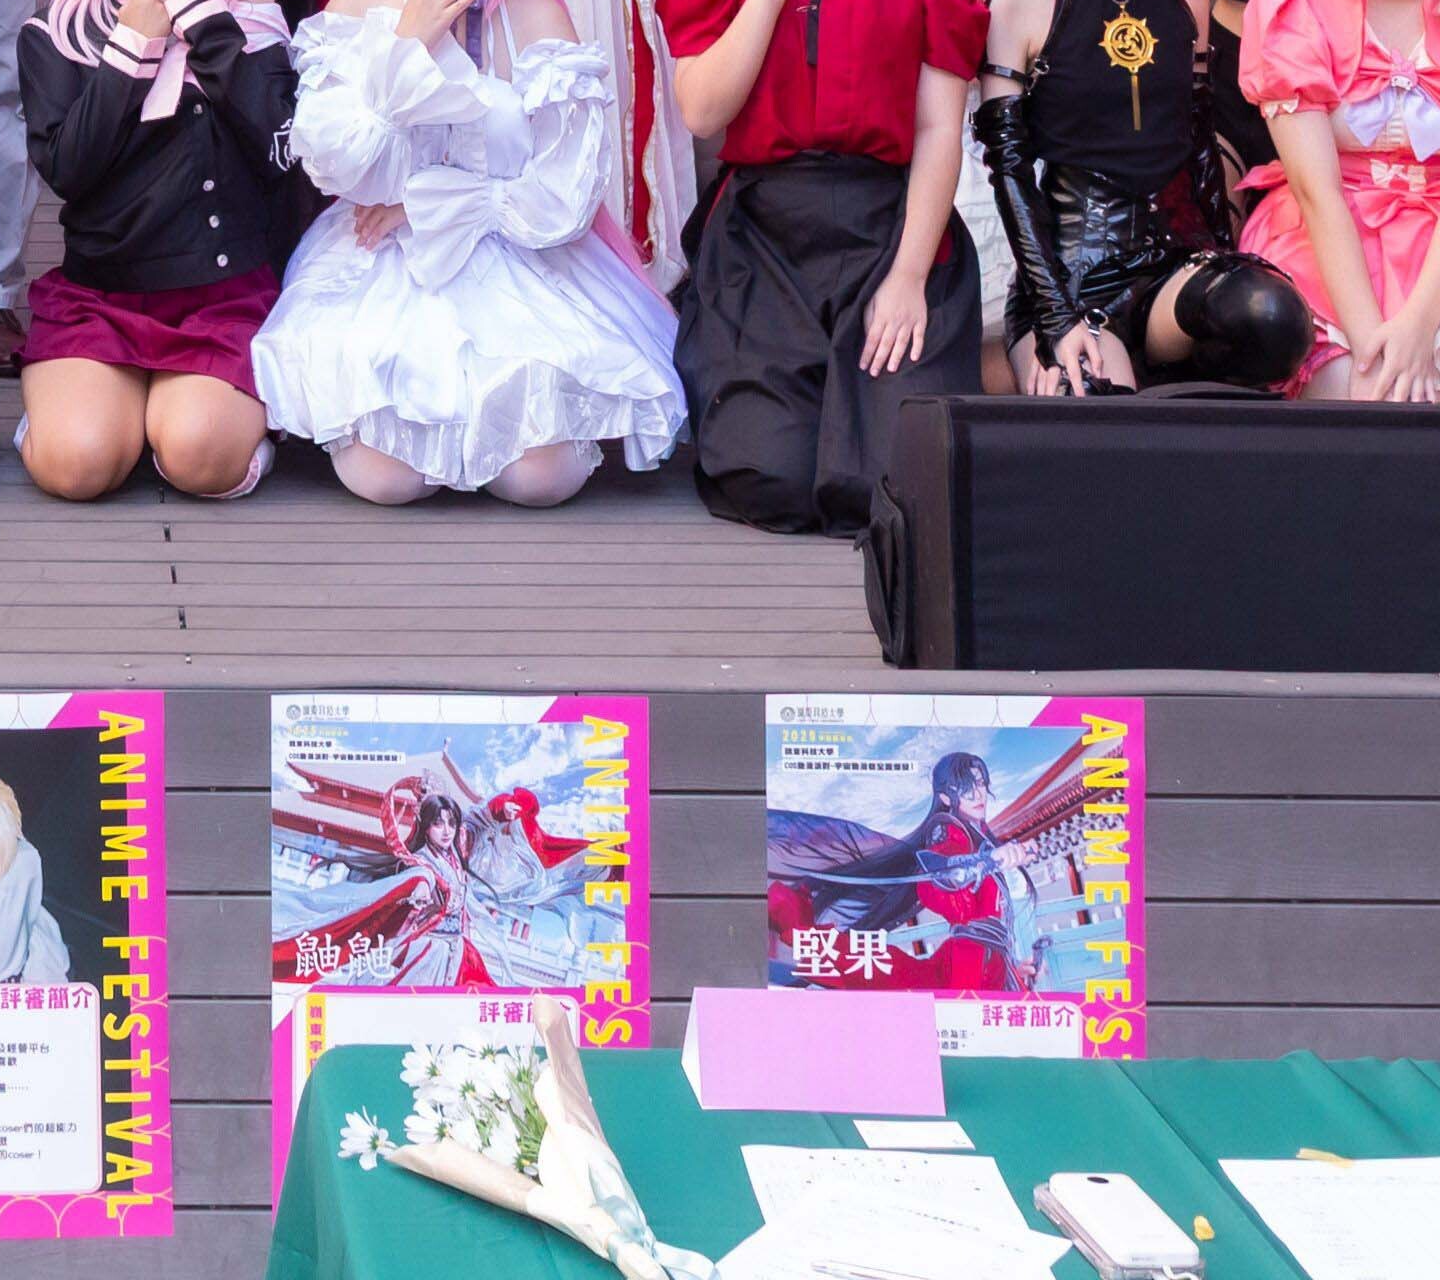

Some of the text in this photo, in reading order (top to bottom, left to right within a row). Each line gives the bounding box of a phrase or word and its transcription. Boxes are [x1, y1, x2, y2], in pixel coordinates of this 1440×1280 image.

[582, 714, 631, 906] ANIME
[1081, 713, 1130, 905] ANIME
[0, 987, 93, 1011] 評審簡介
[99, 710, 154, 1220] ANIME FESTIVAL
[791, 928, 894, 980] 堅果
[982, 1004, 1075, 1028] 評審簡介
